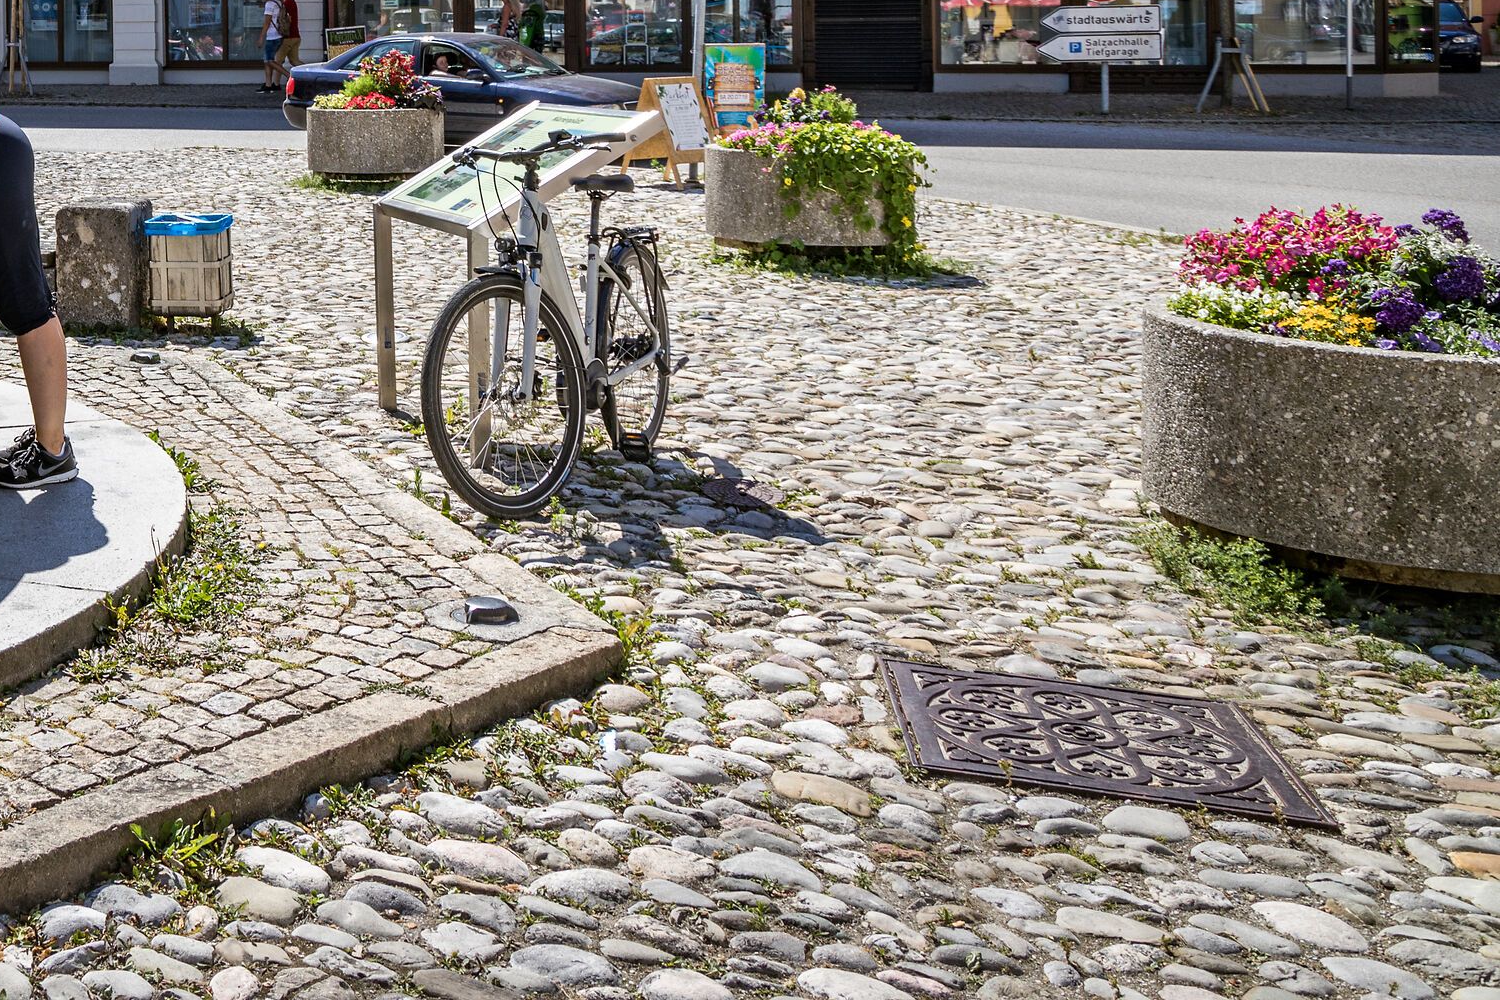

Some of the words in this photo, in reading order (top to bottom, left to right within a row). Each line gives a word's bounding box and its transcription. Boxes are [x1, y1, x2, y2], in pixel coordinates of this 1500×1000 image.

[1066, 14, 1150, 26] stadtauswärts
[1085, 38, 1149, 48] Salzachhalle
[1085, 48, 1140, 57] Tiefgarage
